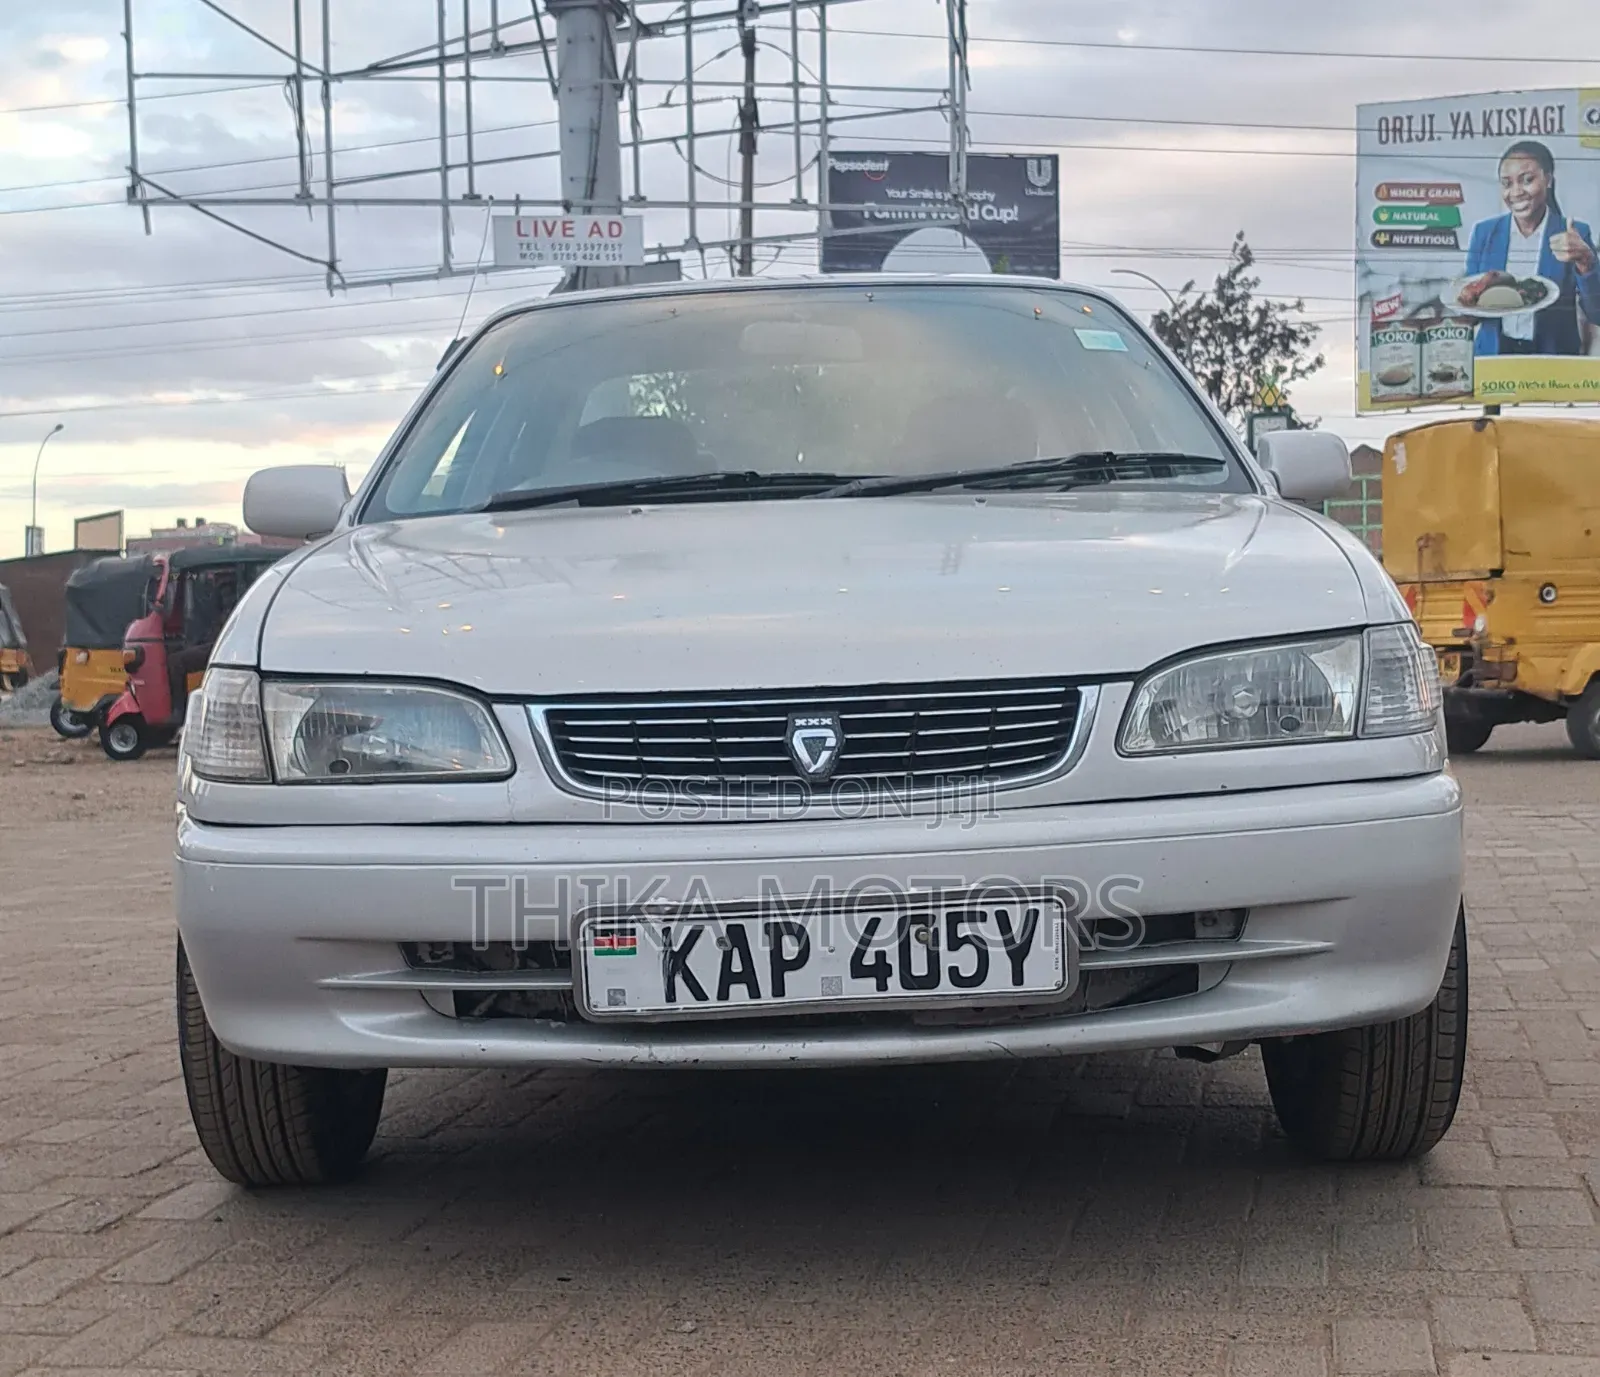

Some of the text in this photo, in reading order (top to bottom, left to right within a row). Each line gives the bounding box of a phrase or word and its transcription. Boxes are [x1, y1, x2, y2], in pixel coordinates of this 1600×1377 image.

[1378, 114, 1441, 145] ORIJI.
[1450, 110, 1475, 140] YA
[1482, 104, 1566, 138] KISIAGI
[828, 158, 889, 173] Pepsodent
[885, 189, 907, 199] Your
[1390, 188, 1461, 198] WHOLE GRAIN
[981, 204, 1018, 223] Cup!
[1392, 211, 1440, 221] NATURAL
[516, 220, 623, 238] LIVE AD
[1392, 234, 1455, 245] NUTRITIOUS
[1373, 297, 1400, 316] NEW
[1378, 331, 1414, 342] SOKO
[1430, 328, 1466, 339] SOKO
[1482, 381, 1516, 391] SOKO
[661, 921, 811, 1003] KAP
[850, 908, 1040, 992] 405Y
